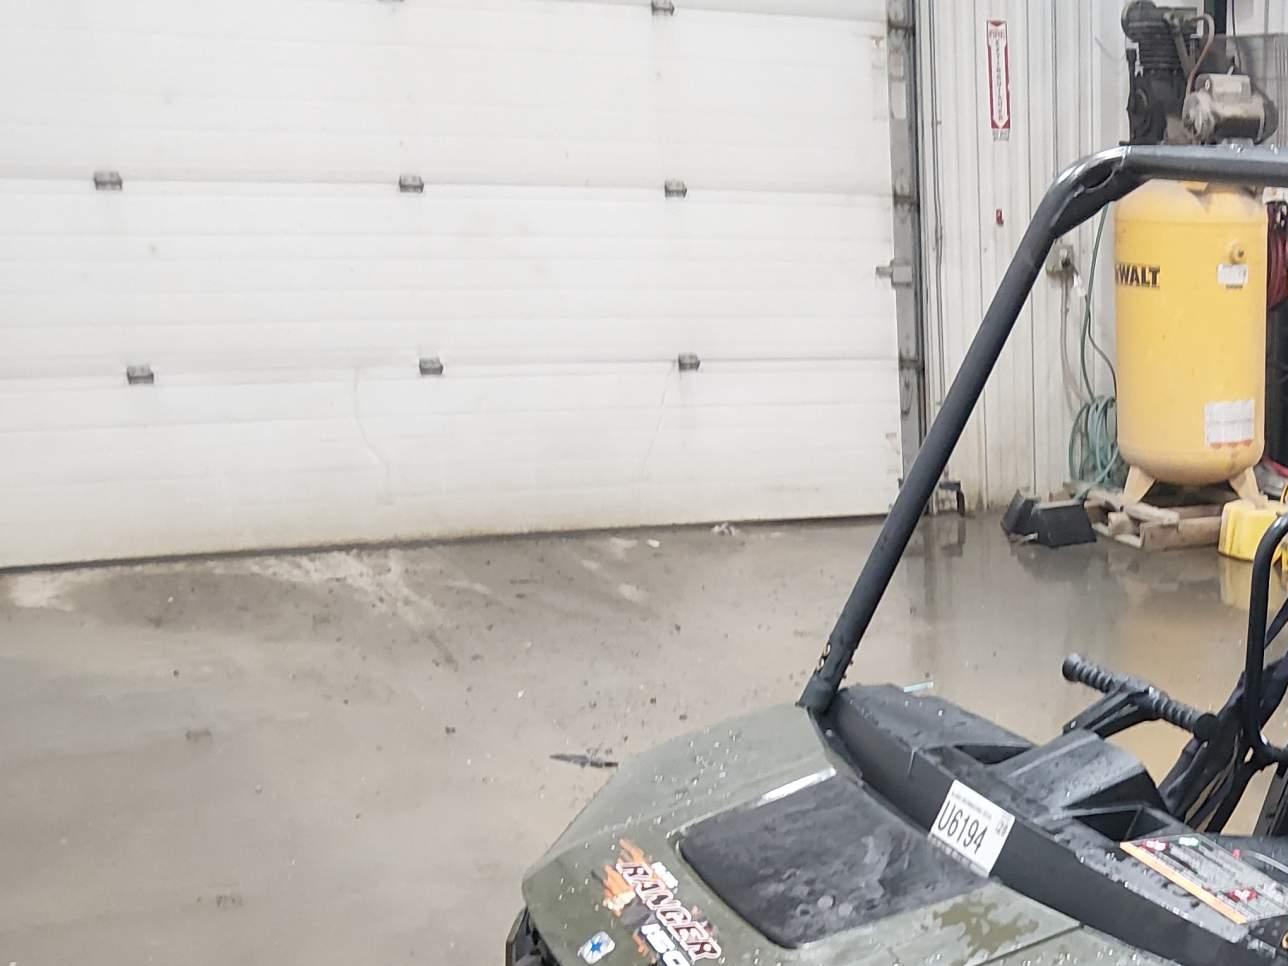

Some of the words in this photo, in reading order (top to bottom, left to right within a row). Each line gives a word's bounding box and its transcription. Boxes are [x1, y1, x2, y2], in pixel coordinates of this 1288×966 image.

[1114, 263, 1161, 288] WALT
[938, 800, 988, 854] U6194
[616, 862, 722, 961] RANGER
